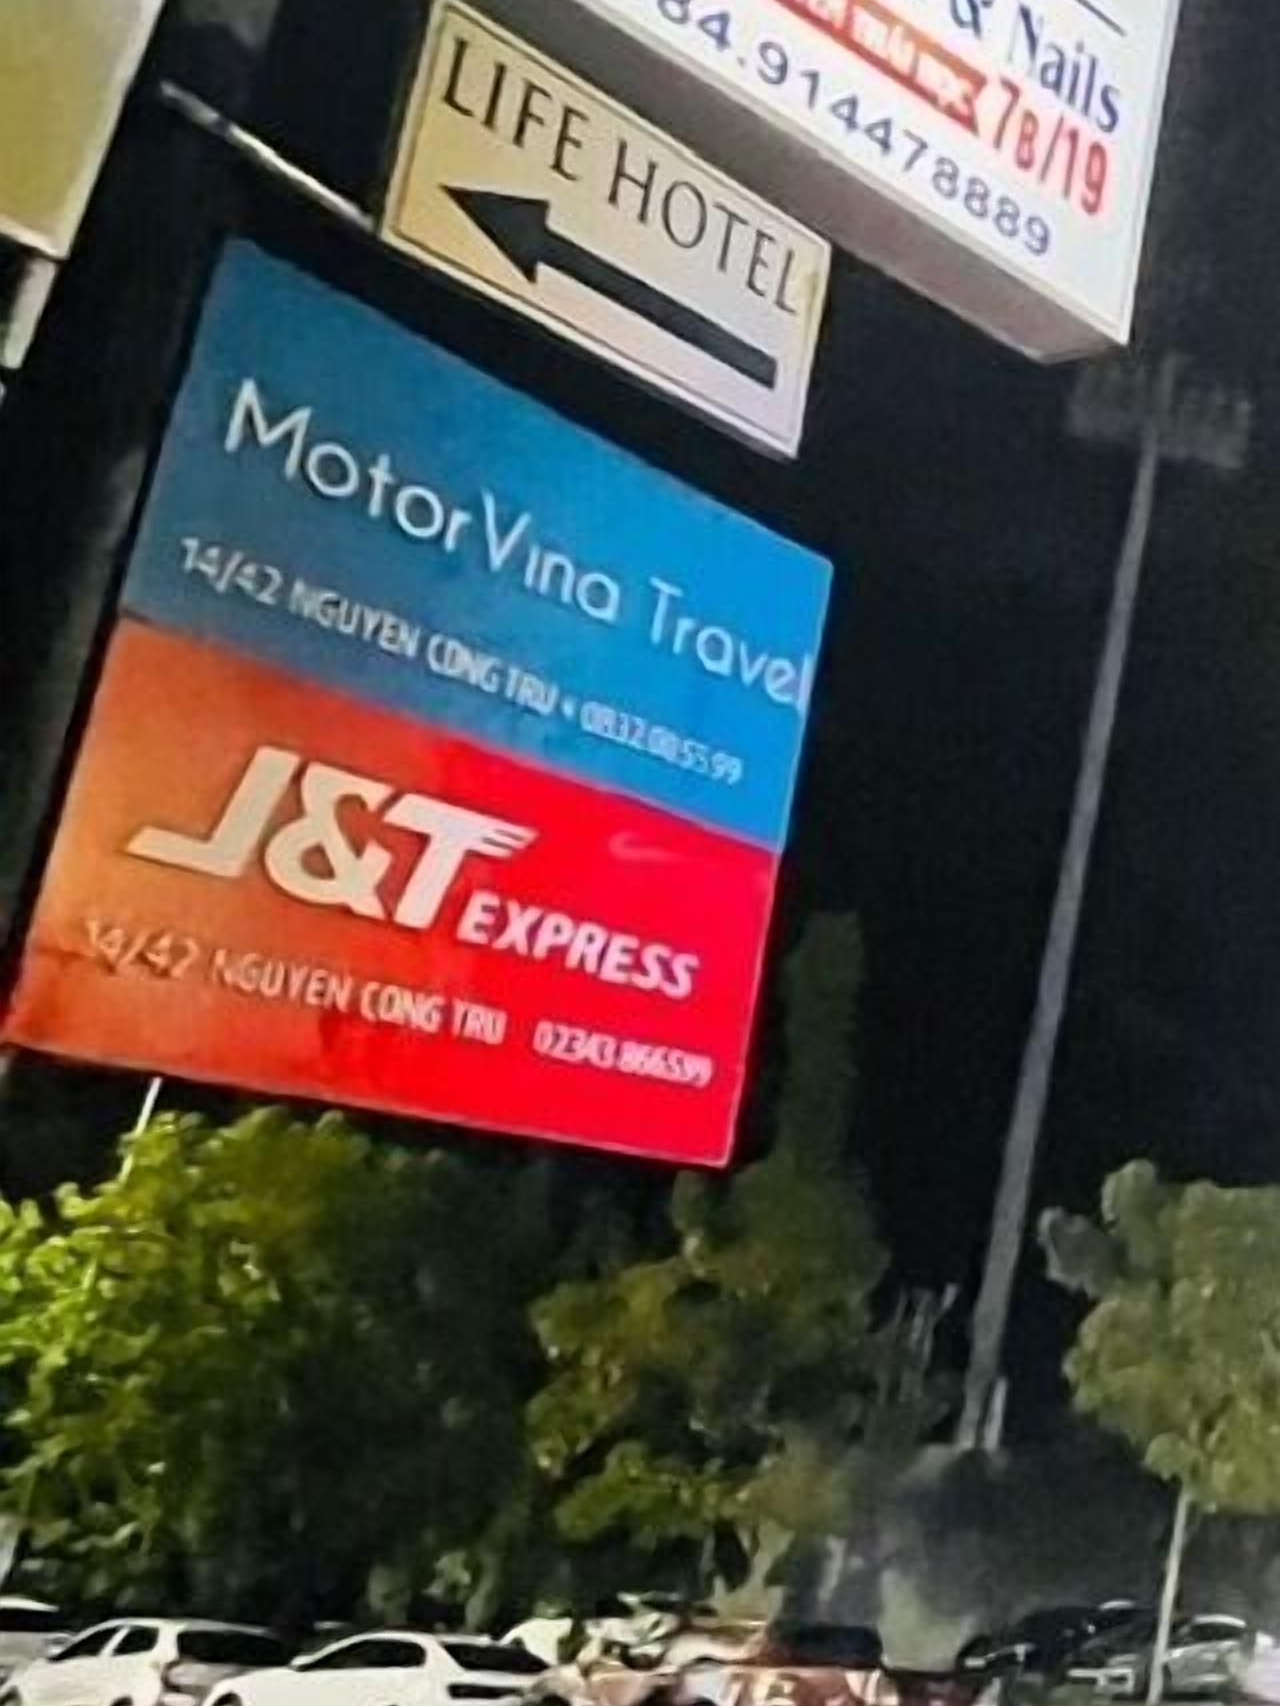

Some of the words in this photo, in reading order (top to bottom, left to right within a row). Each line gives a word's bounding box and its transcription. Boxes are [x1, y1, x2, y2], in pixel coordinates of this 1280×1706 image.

[1006, 2, 1122, 135] Nails
[446, 38, 589, 181] LIFE
[608, 135, 797, 315] HOTEL
[644, 577, 813, 714] Travel
[126, 745, 536, 930] J&T
[457, 894, 700, 998] EXPRESS
